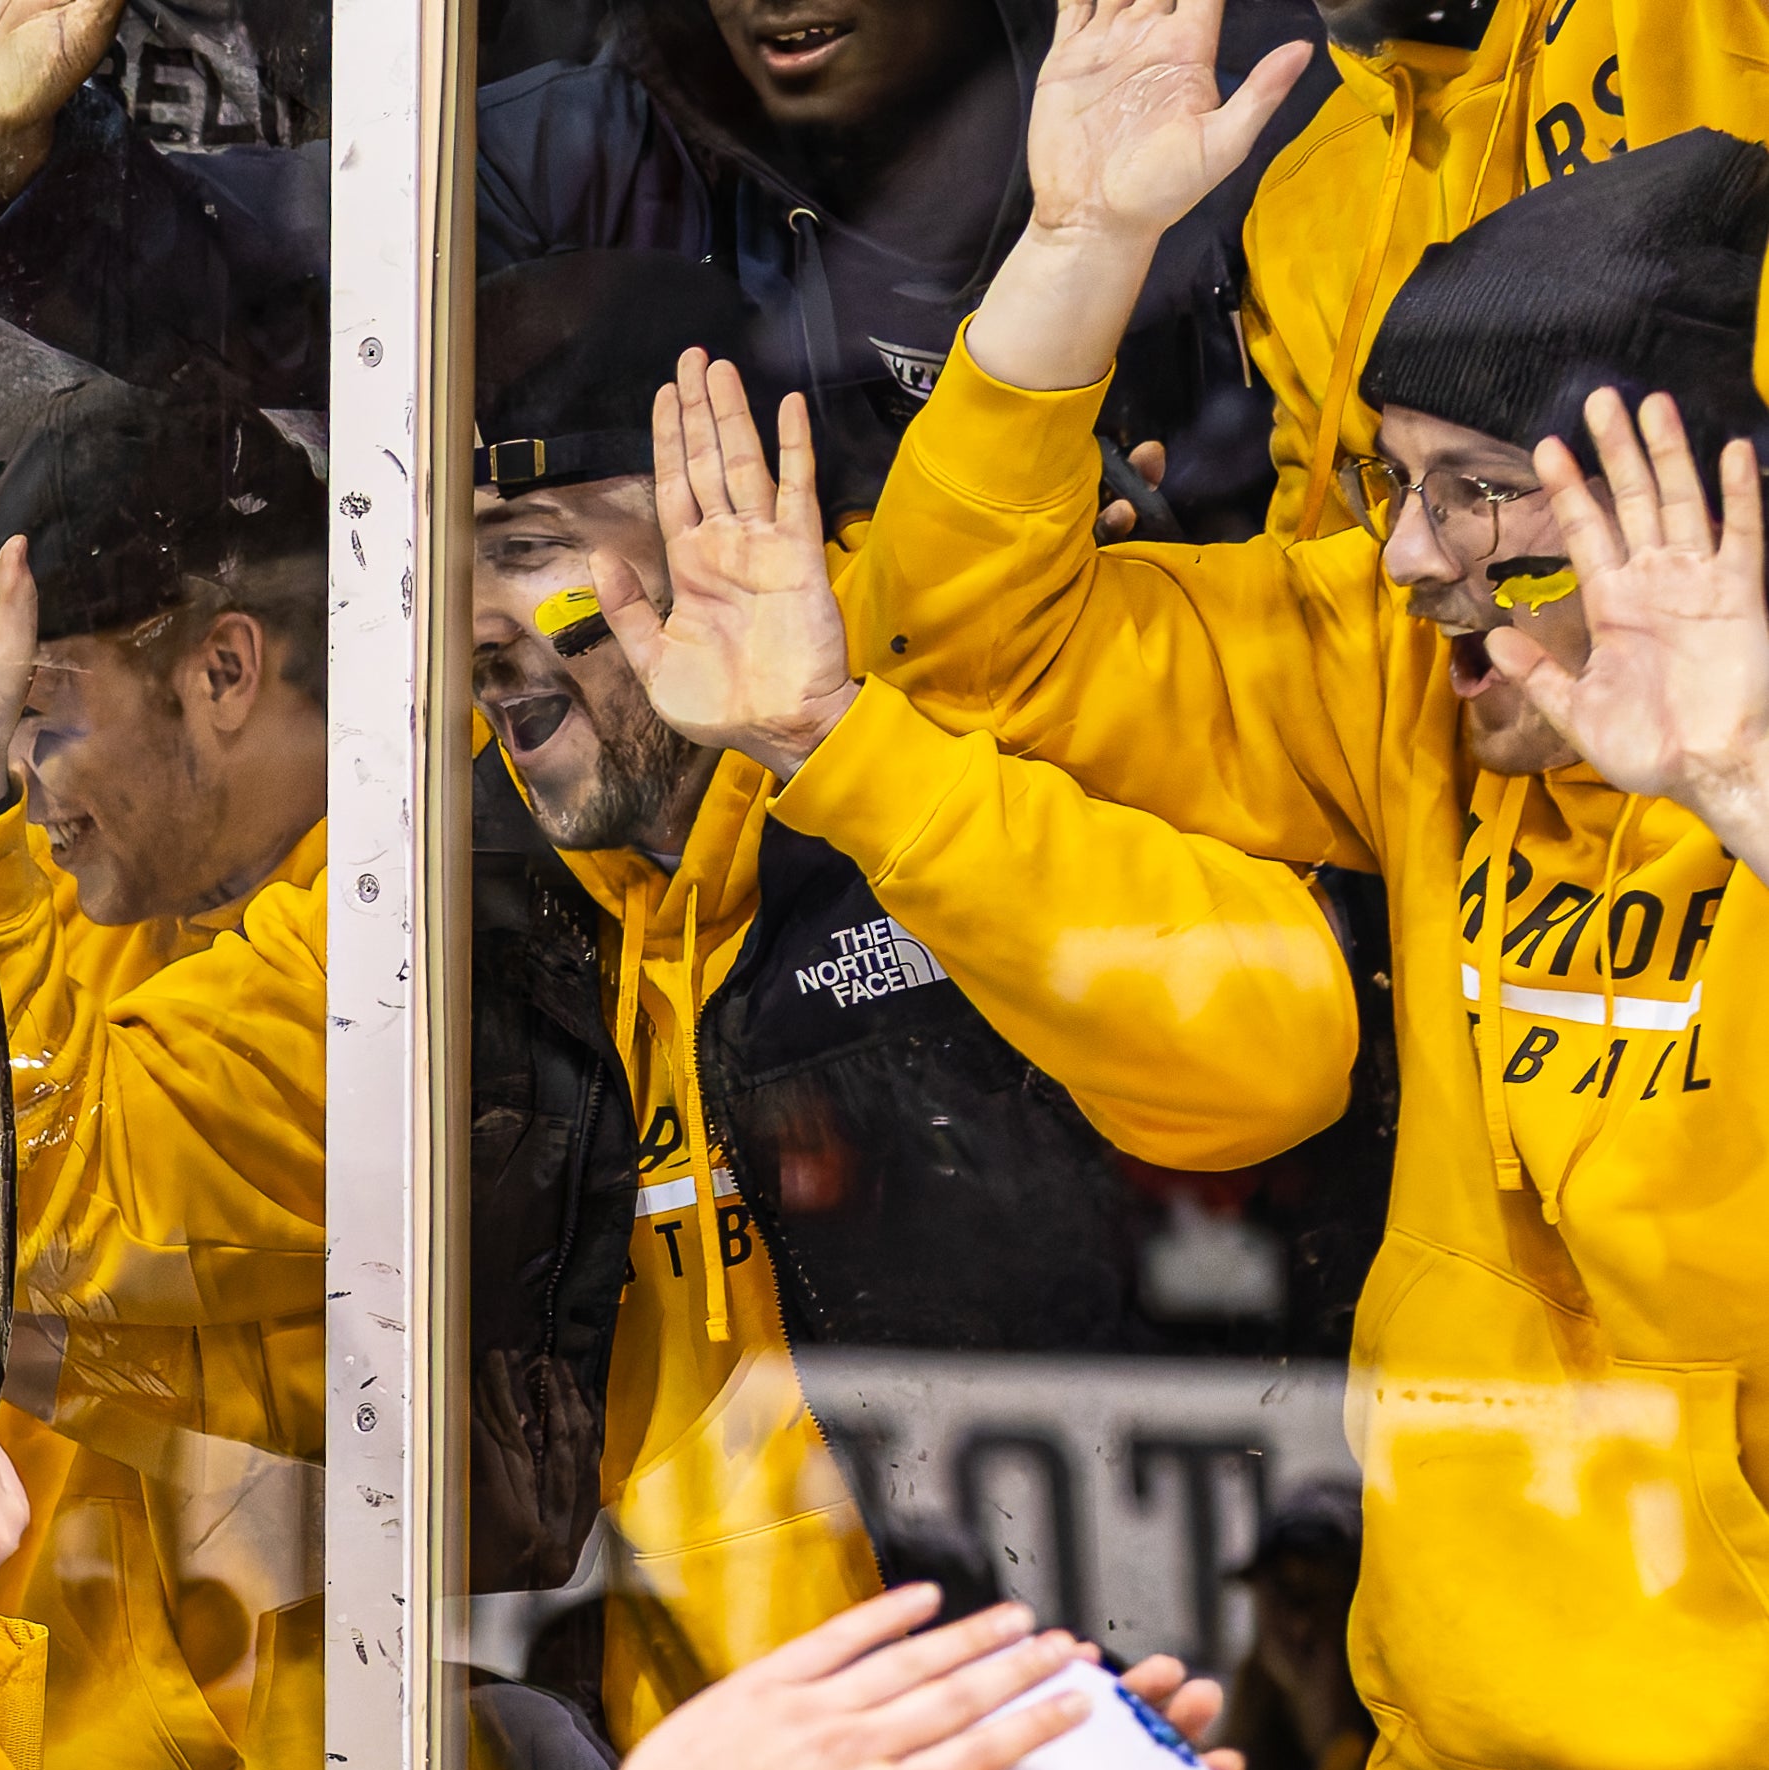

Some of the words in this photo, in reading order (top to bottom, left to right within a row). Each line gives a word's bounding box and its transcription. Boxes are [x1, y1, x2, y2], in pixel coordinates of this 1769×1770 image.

[831, 918, 891, 955] THE
[795, 942, 897, 994] NORTH
[831, 966, 907, 1008] FACE
[1467, 1010, 1711, 1102] BALL
